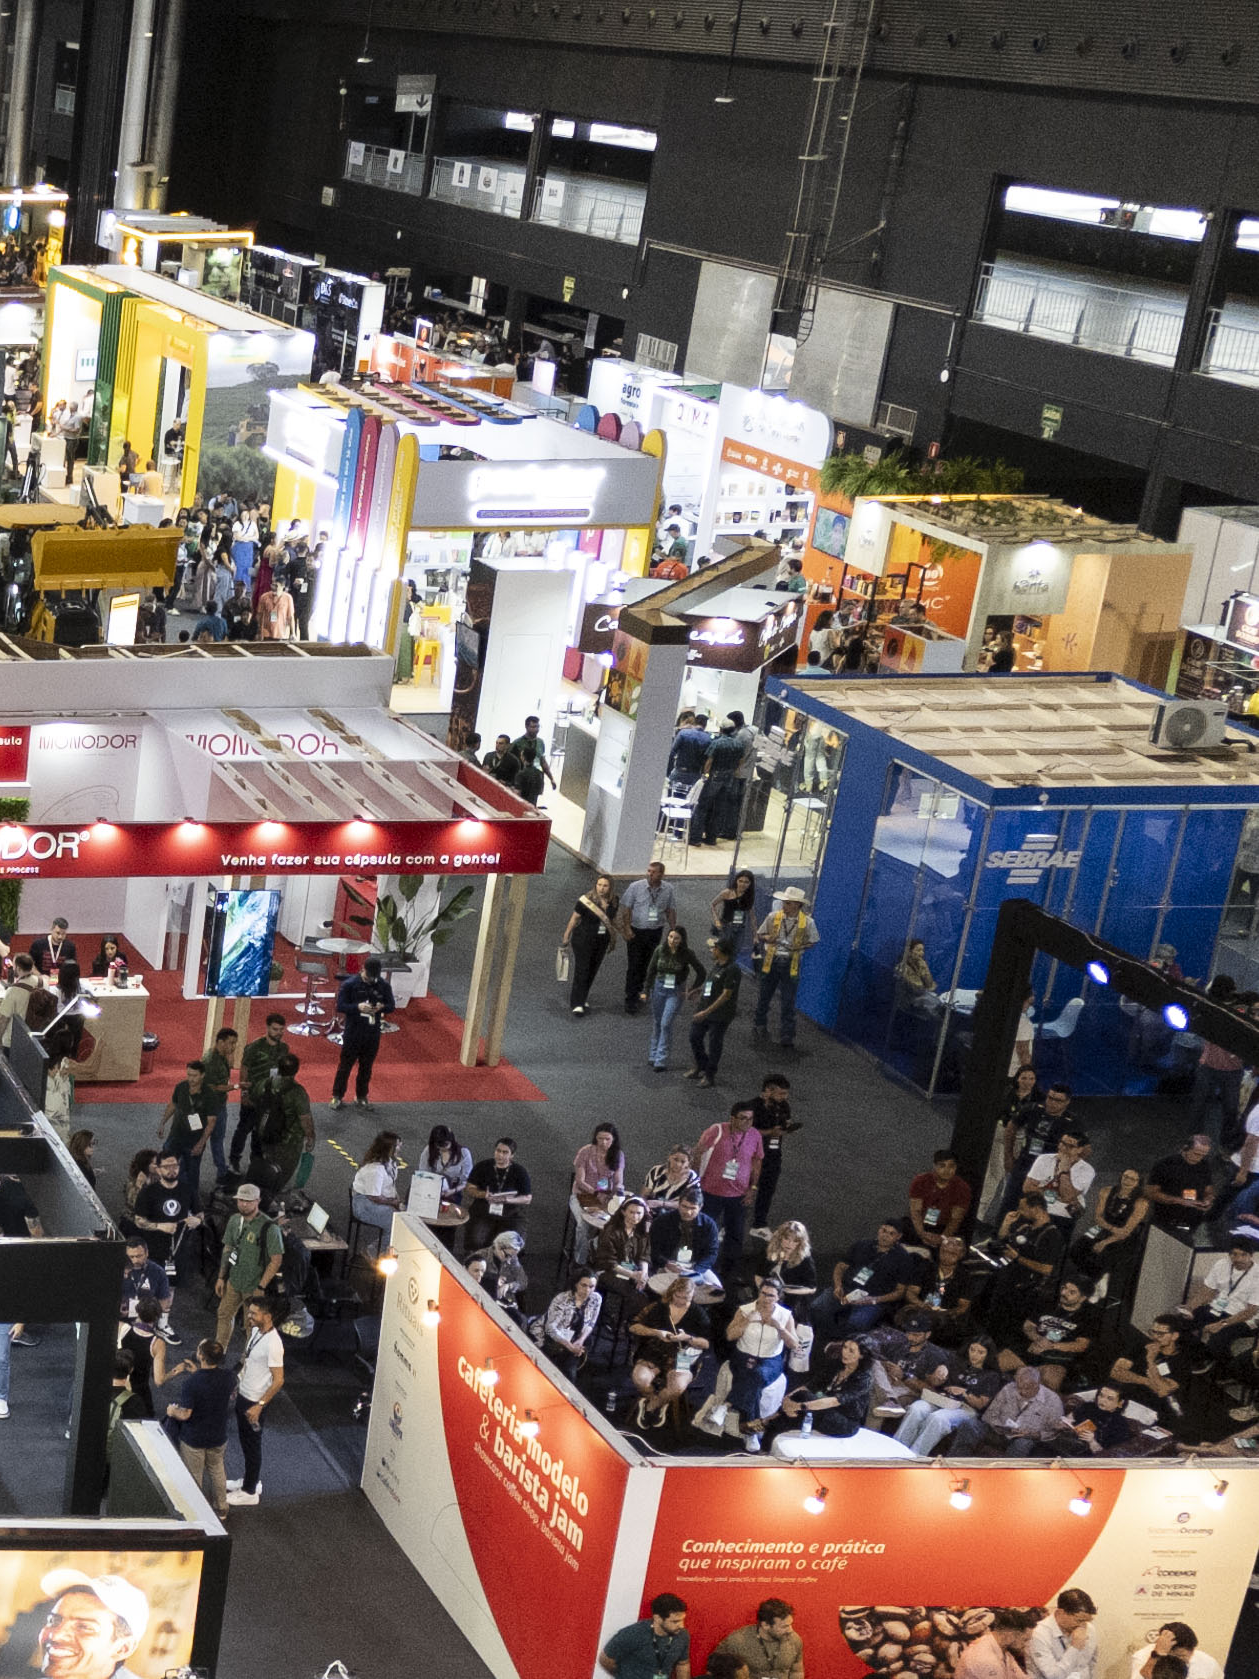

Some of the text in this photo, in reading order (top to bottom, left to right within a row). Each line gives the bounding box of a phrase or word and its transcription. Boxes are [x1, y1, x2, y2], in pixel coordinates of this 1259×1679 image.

[39, 734, 137, 749] MONODOR
[221, 851, 502, 868] Venha fazer sua cápsula com a gente!
[985, 850, 1083, 868] SEBRAE
[457, 1355, 589, 1517] cafeteria modelo
[479, 1414, 584, 1552] & barista jam
[503, 1475, 524, 1506] coffee
[682, 1538, 886, 1556] Conhecimento e prática
[678, 1554, 848, 1572] que inspiram o café
[1153, 1583, 1197, 1591] GOVERNO
